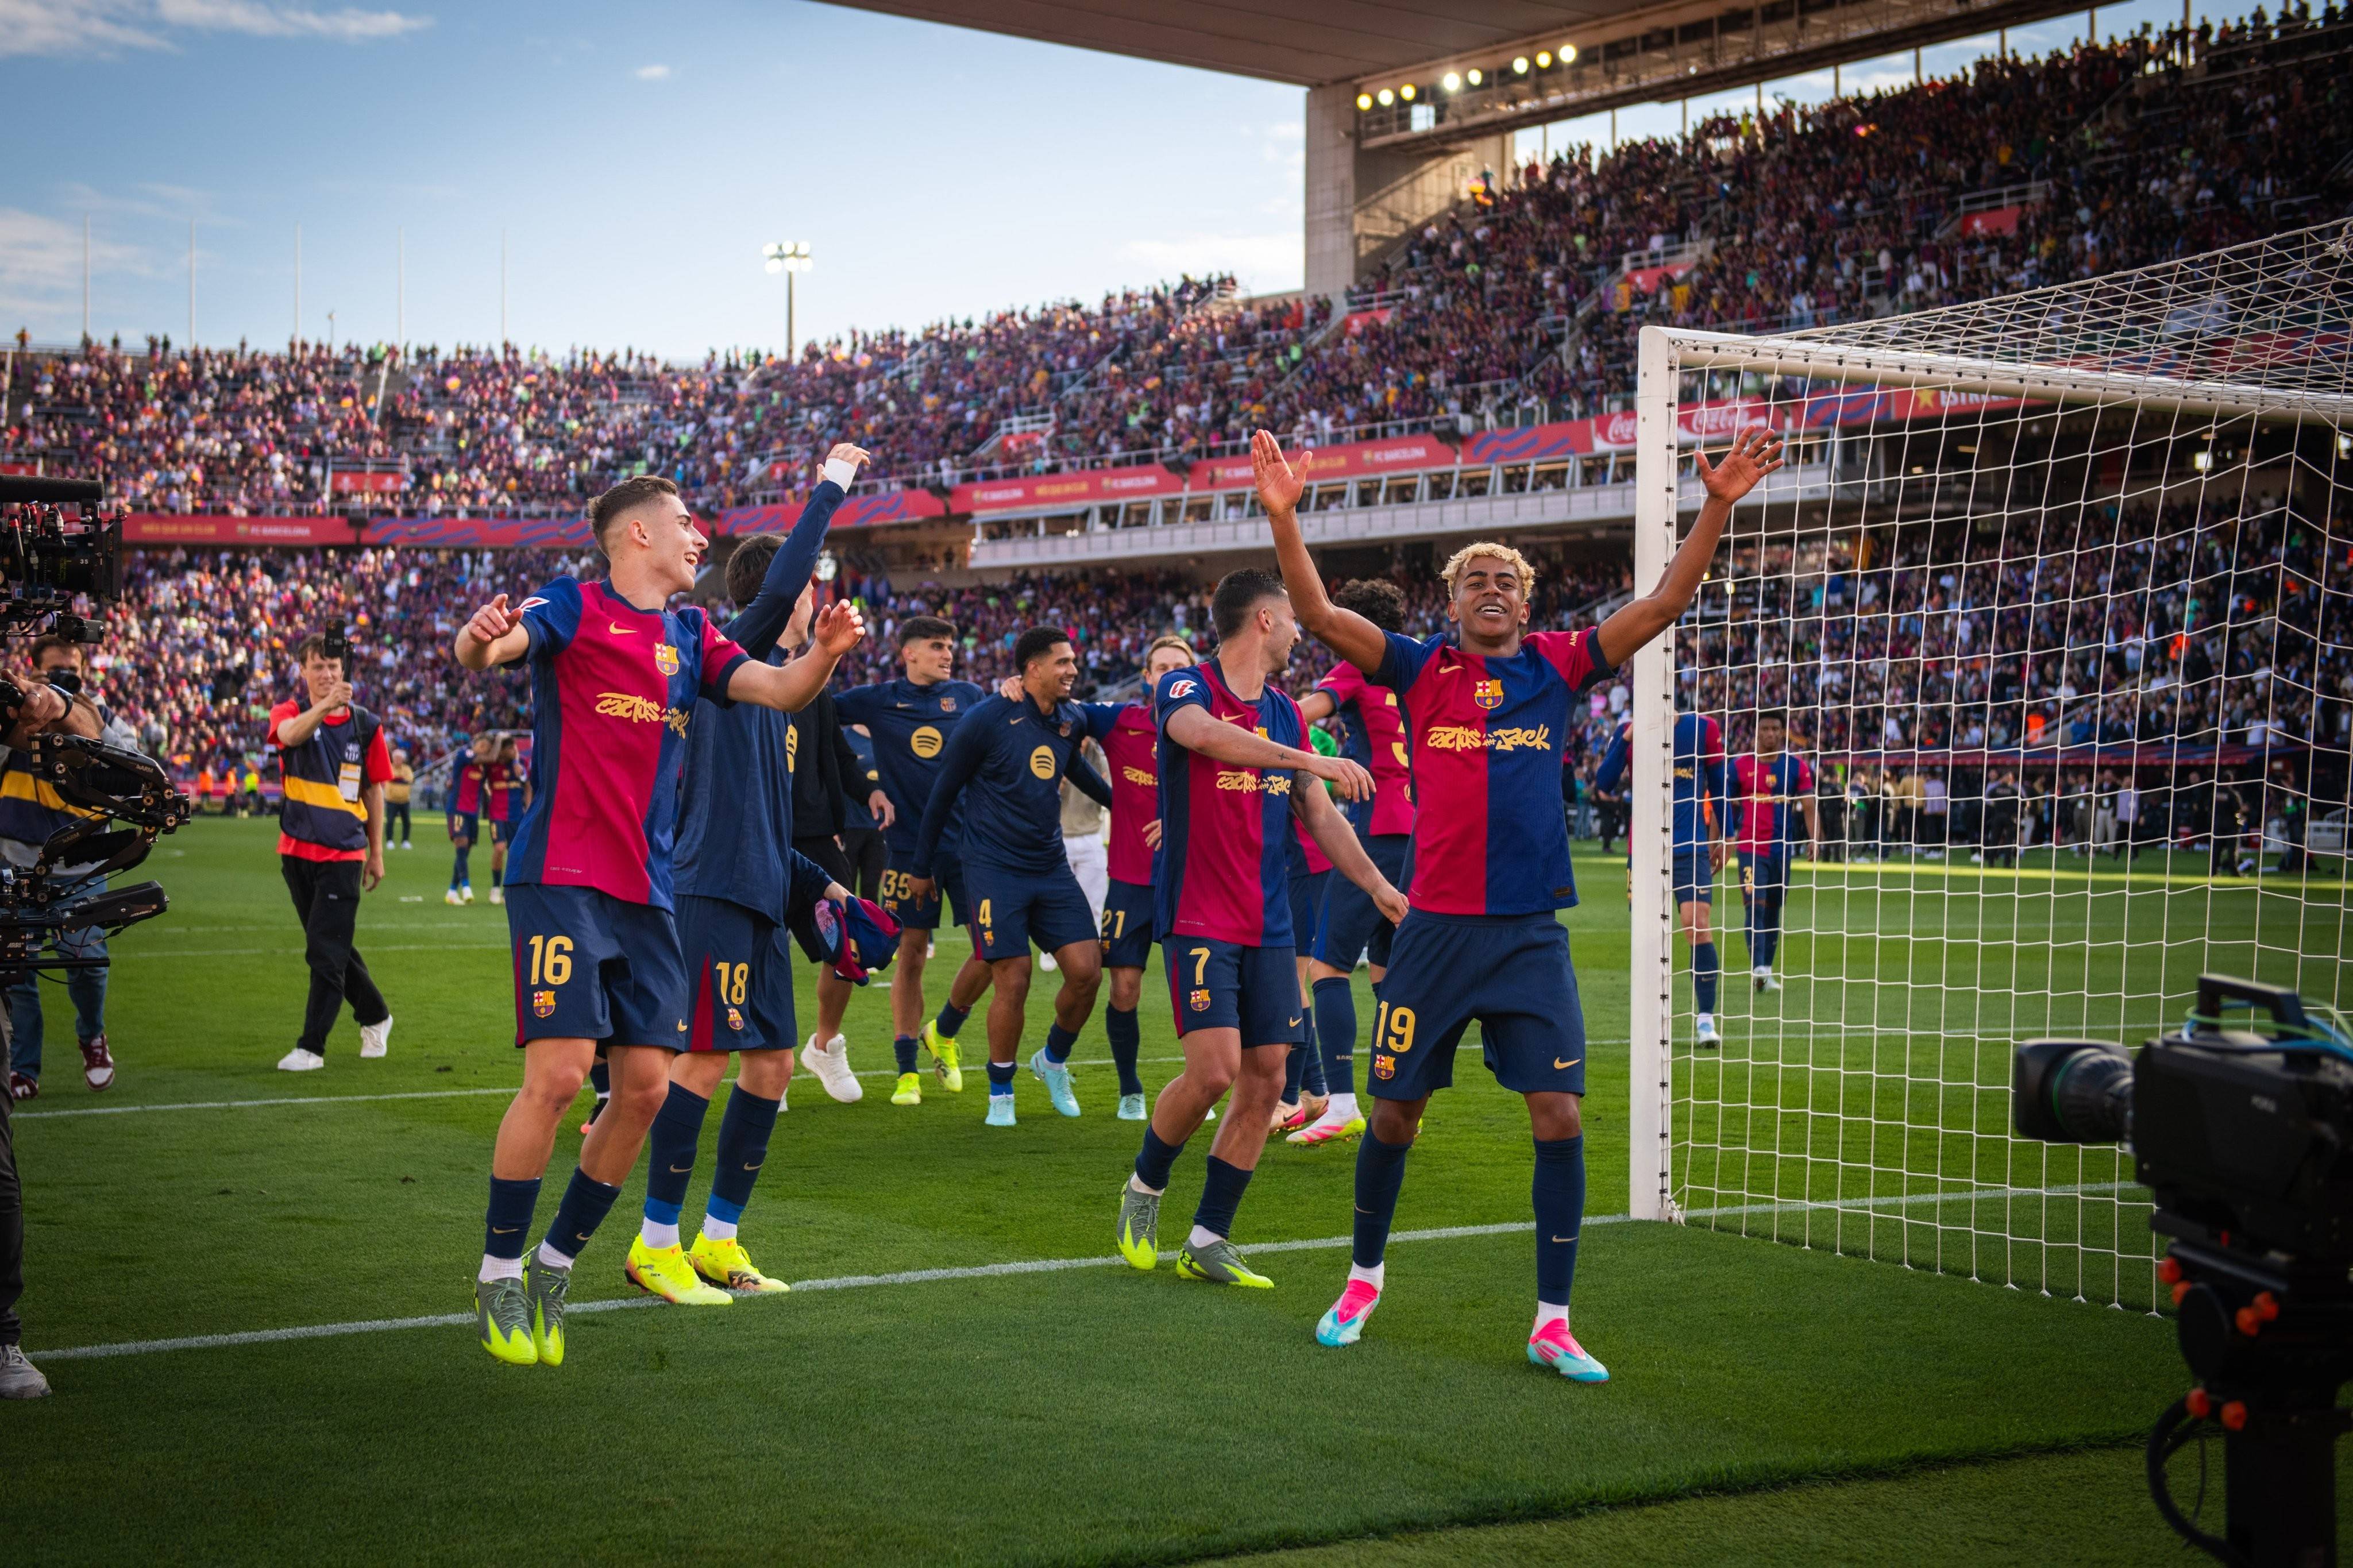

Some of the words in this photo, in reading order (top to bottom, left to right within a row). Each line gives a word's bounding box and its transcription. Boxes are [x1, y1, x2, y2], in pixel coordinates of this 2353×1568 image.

[883, 869, 912, 901] 35
[978, 899, 992, 928] 4
[1102, 909, 1125, 939] 21
[529, 934, 574, 985] 16
[1189, 947, 1211, 985] 7
[715, 962, 749, 1005] 18
[1376, 1001, 1416, 1053] 19
